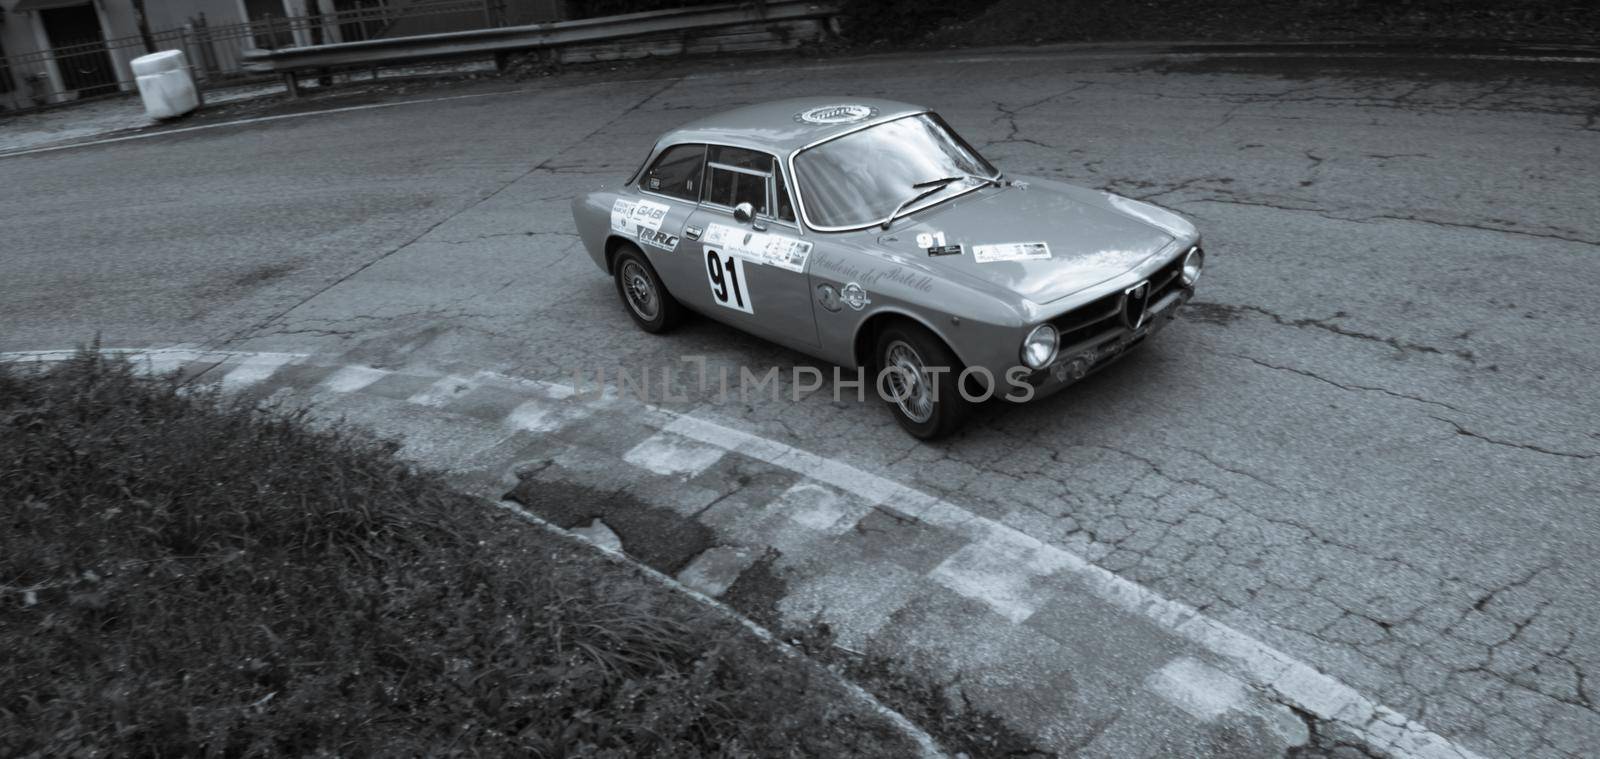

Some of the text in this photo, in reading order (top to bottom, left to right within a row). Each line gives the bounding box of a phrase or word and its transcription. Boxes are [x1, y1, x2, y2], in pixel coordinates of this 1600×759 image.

[640, 227, 679, 247] RRC
[915, 231, 946, 249] 91
[707, 250, 744, 309] 91
